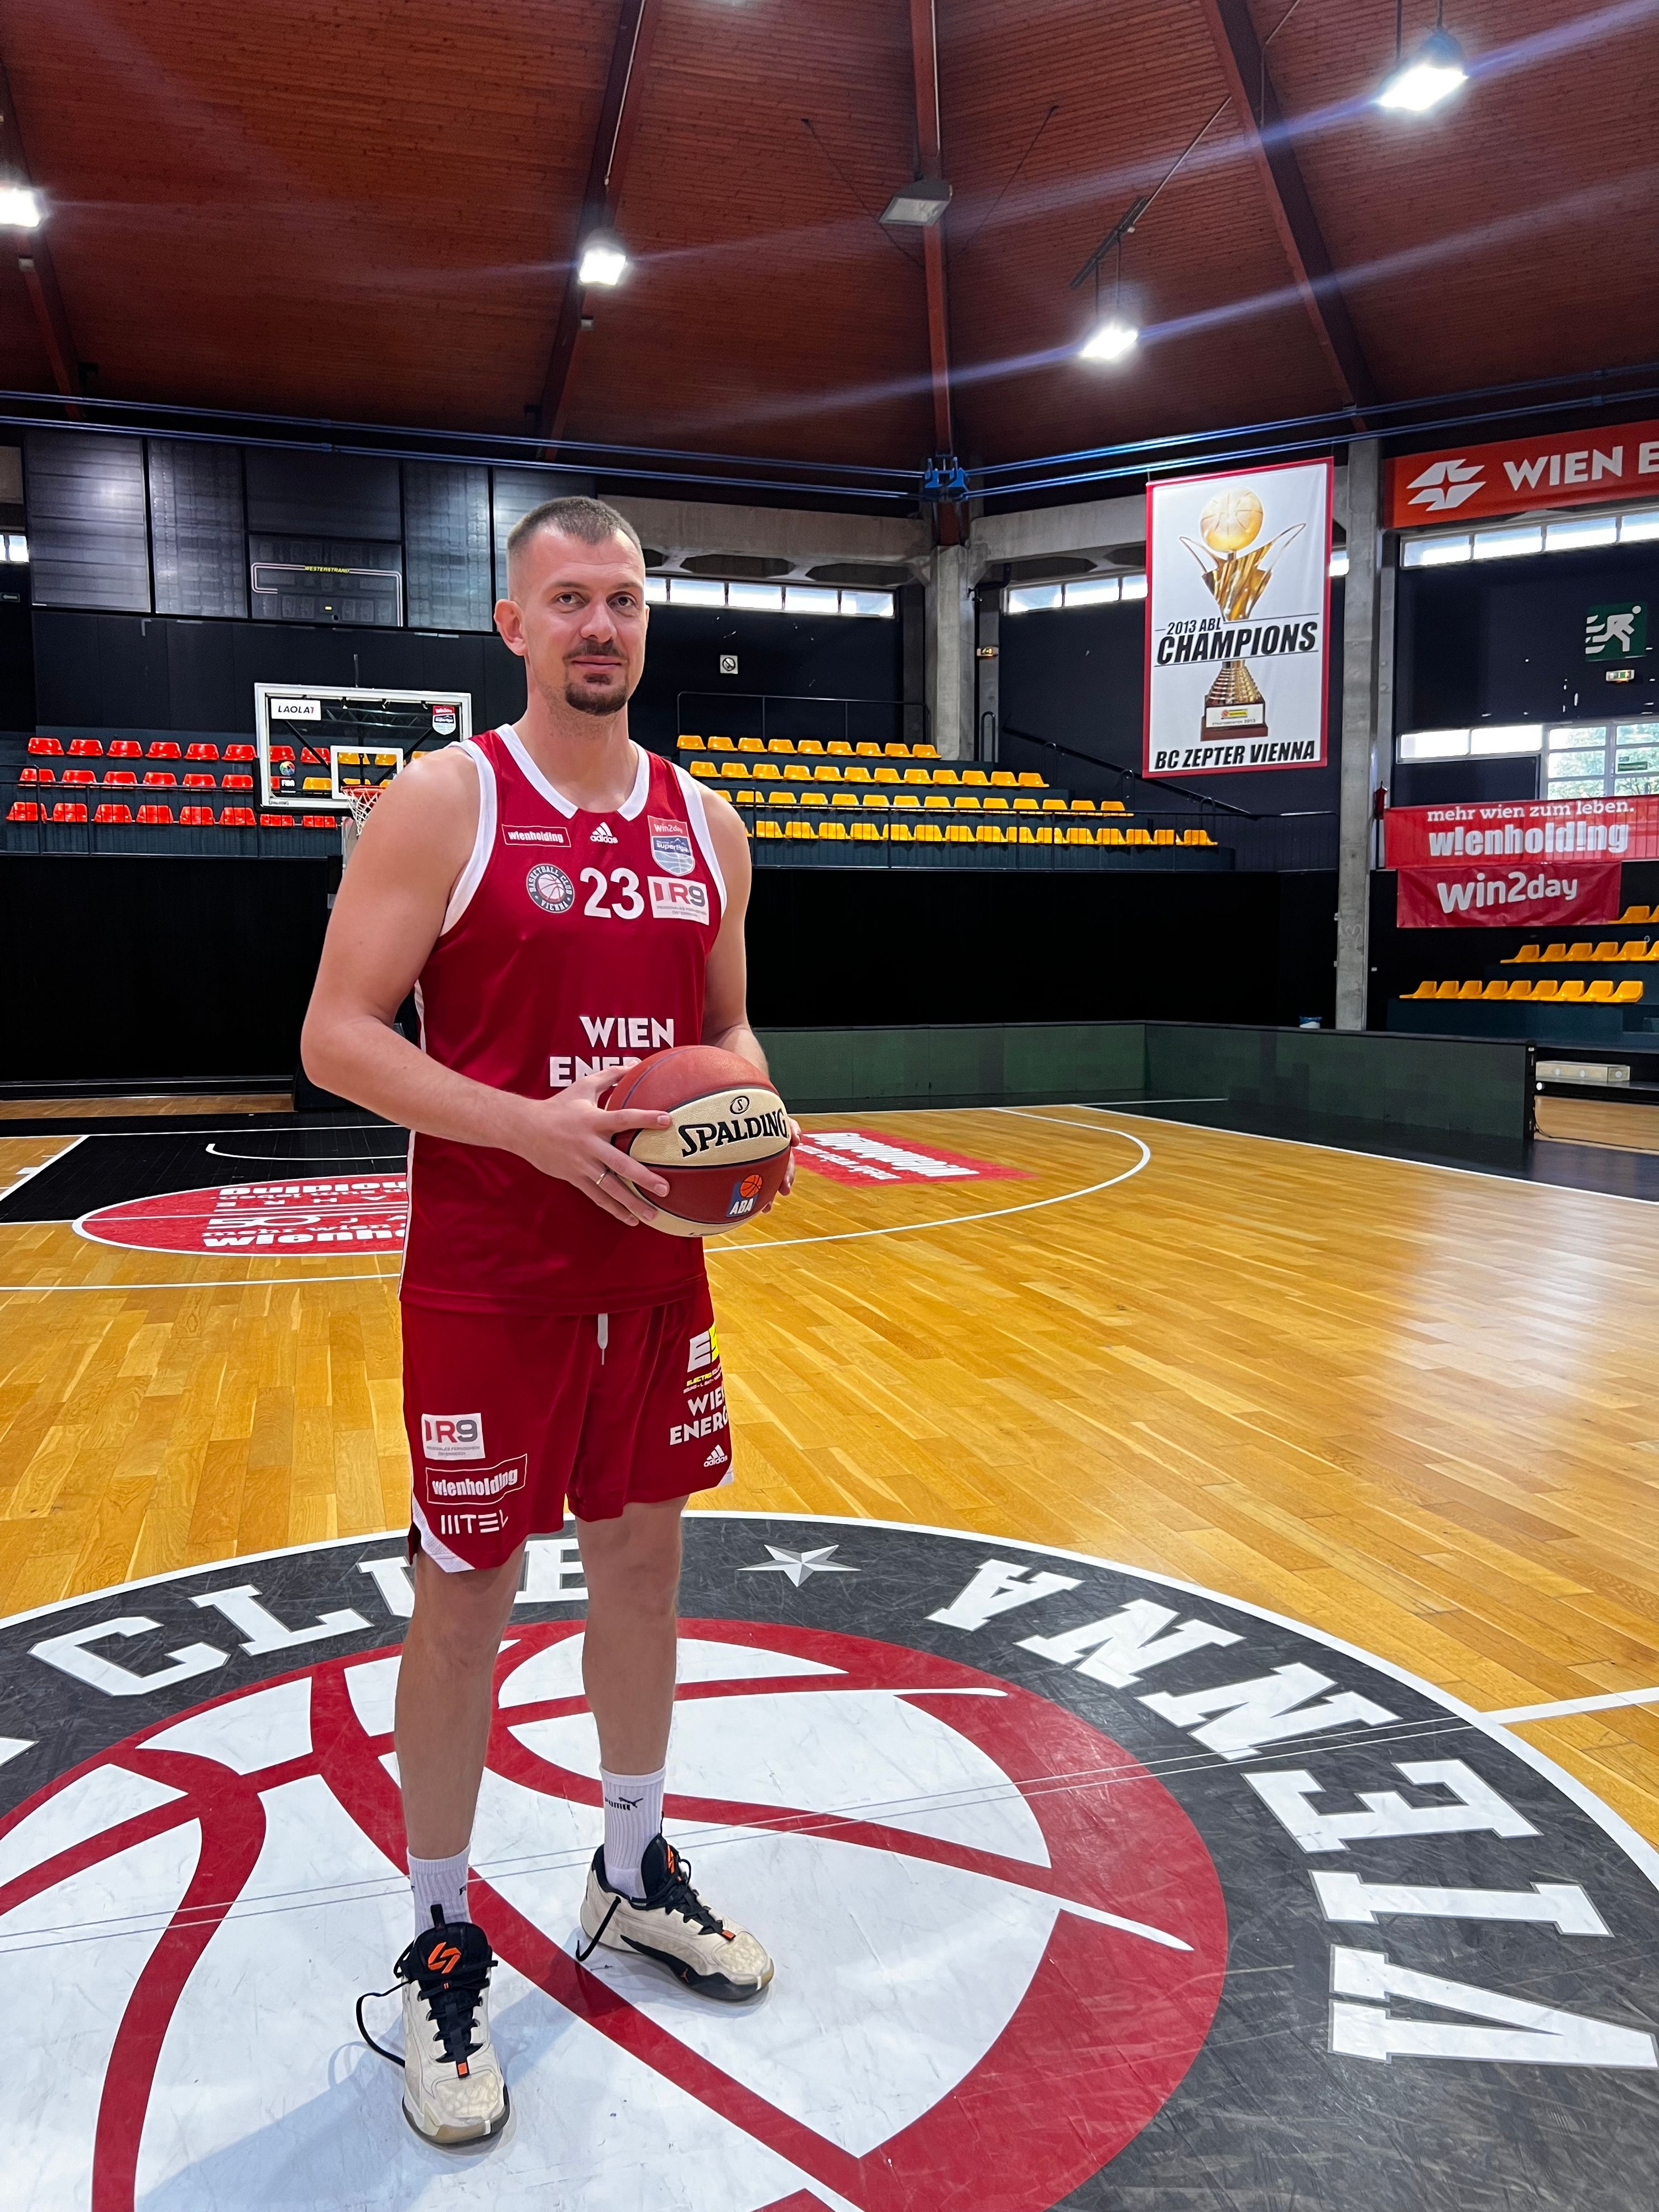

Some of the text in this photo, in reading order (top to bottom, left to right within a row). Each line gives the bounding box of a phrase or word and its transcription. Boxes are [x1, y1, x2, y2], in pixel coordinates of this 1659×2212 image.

[1503, 445, 1624, 491] WIEN
[305, 566, 350, 574] WESTERSTRAND
[1167, 617, 1221, 635] 2013 ABL
[1157, 621, 1318, 665] CHAMPIONS
[1155, 740, 1315, 769] BC ZEPTER VIENNA
[1427, 800, 1635, 822] mehr wien zum leben.
[590, 835, 618, 844] adidas
[528, 866, 573, 895] BASKETBALL CLUB
[580, 867, 645, 920] 23
[1437, 871, 1578, 914] win2day
[540, 899, 569, 911] VIENNA
[580, 1016, 674, 1048] WIEN
[678, 1108, 789, 1157] SPALDING
[729, 1198, 754, 1215] ABA
[703, 1454, 728, 1468] adidas
[924, 1557, 1659, 2070] VIENNA
